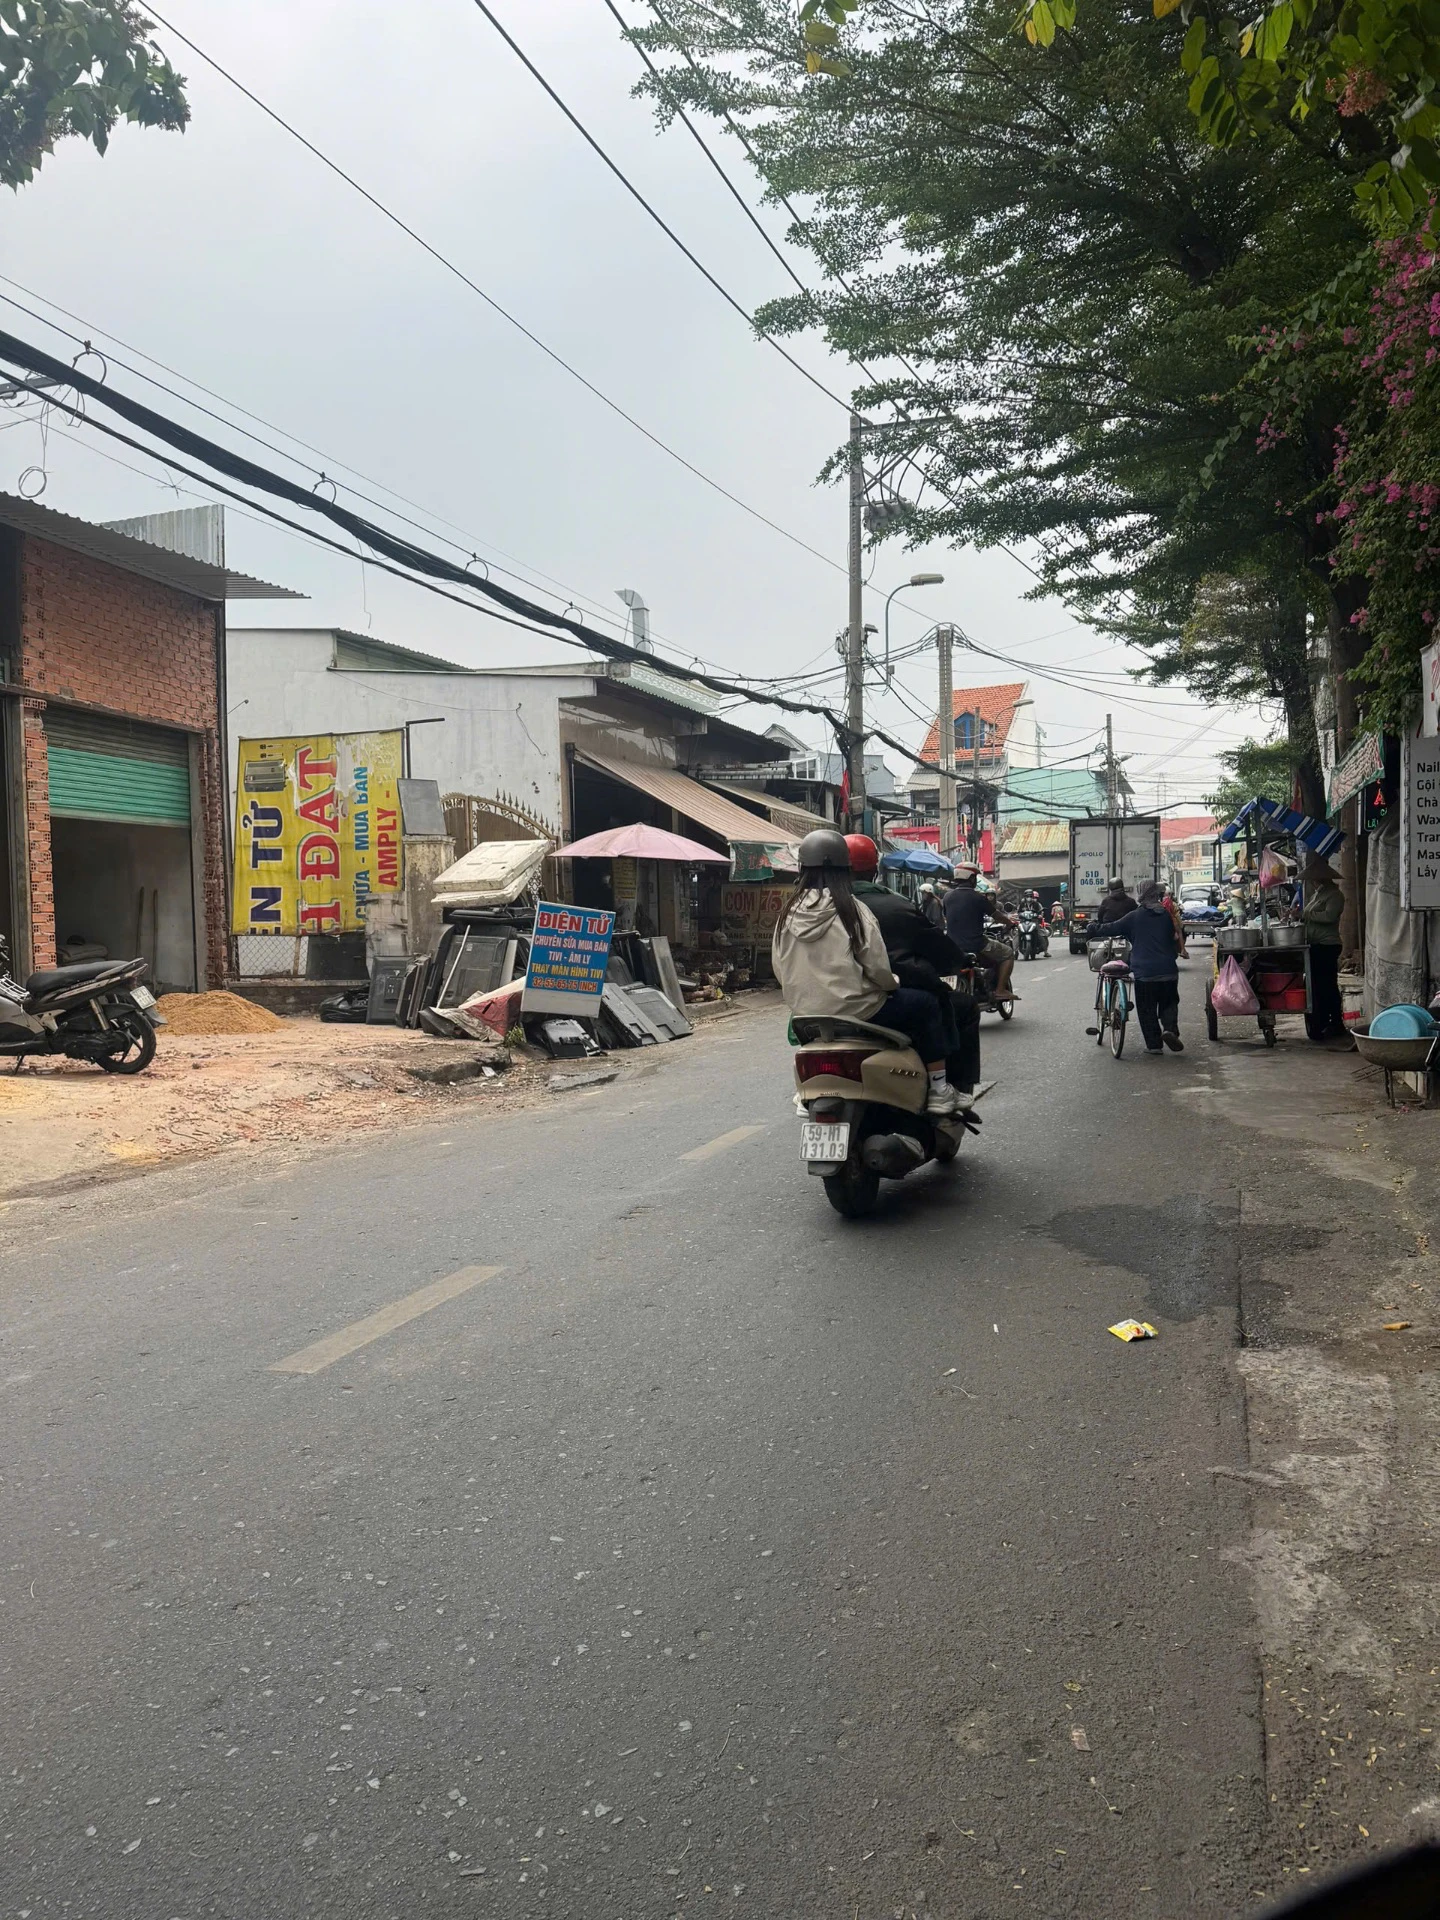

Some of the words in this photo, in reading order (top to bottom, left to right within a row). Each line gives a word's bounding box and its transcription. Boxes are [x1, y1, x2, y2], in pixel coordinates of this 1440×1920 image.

[1417, 761, 1440, 773] Nail
[1417, 779, 1435, 792] Gội
[1417, 796, 1438, 808] Chà
[1416, 814, 1440, 825] Wax
[243, 800, 284, 869] TỬ
[354, 809, 370, 851] MUA
[377, 806, 398, 887] AMPLY
[1085, 870, 1099, 878] 51D
[1417, 865, 1438, 880] Lấy
[538, 910, 583, 933] ĐIỆN
[587, 913, 612, 935] TỬ
[534, 934, 562, 948] CHUYÊN
[577, 939, 593, 951] MUA
[593, 940, 608, 953] BÁN
[548, 951, 563, 961] TIVI
[582, 954, 592, 965] LY
[531, 963, 550, 974] THAY
[551, 963, 569, 976] MÀN
[570, 965, 588, 977] HÌNH
[590, 968, 604, 979] TIVI
[578, 981, 598, 992] INCH
[808, 1125, 841, 1142] 59-H1
[803, 1142, 845, 1159] 131.03
